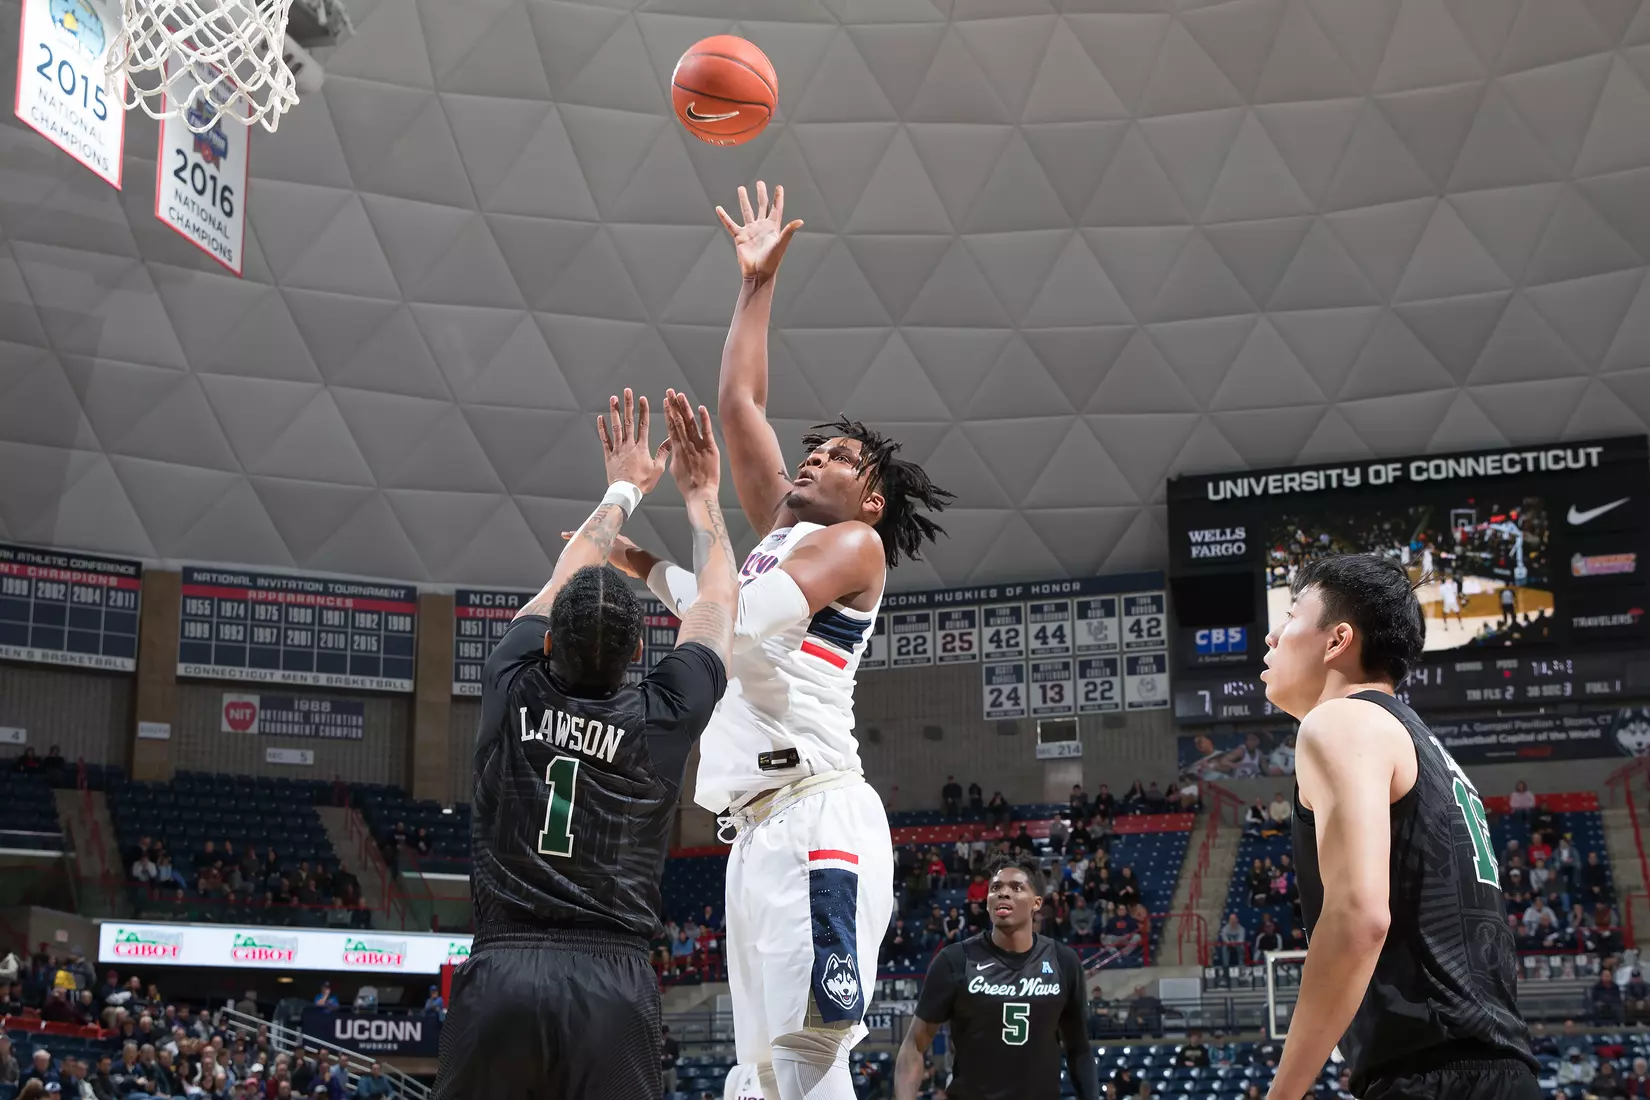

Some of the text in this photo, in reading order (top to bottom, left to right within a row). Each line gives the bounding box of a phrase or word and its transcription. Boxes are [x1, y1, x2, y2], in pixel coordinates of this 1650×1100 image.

[36, 43, 108, 121] 2015
[38, 86, 106, 146] NATIONAL
[31, 106, 109, 172] CHAMPIONS
[173, 148, 234, 219] 2016
[174, 188, 230, 240] NATIONAL
[168, 205, 233, 262] CHAMPIONS
[1207, 446, 1604, 501] UNIVERSITY OF CONNECTICUT
[1188, 527, 1246, 544] WELLS
[1191, 541, 1246, 559] FARGO
[27, 566, 118, 586] CHAMPIONS
[193, 572, 407, 599] NATIONAL INVITATION TOURNAMENT
[37, 582, 66, 600] 2002
[72, 586, 101, 604] 2004
[108, 591, 136, 609] 2011
[248, 590, 354, 608] APPEARANCES
[469, 594, 519, 606] NCAA
[935, 588, 998, 602] HUSKIES
[1006, 586, 1024, 597] OF
[1031, 582, 1081, 595] HONOR
[186, 599, 211, 616] 1955
[220, 601, 245, 618] 1974
[254, 604, 279, 621] 1975
[460, 620, 482, 636] 1951
[1034, 624, 1066, 645] 44
[1129, 617, 1161, 638] 42
[1195, 627, 1242, 645] CBS
[253, 627, 277, 644] 1997
[287, 629, 312, 647] 2001
[320, 632, 346, 649] 2010
[353, 635, 378, 652] 2015
[897, 635, 927, 657] 22
[942, 631, 973, 653] 25
[988, 628, 1020, 649] 42
[41, 651, 128, 669] BASKETBALL
[459, 642, 482, 658] 1963
[184, 665, 276, 681] CONNECTICUT
[326, 676, 408, 691] BASKETBALL
[460, 665, 481, 680] 1991
[989, 686, 1020, 708] 24
[1039, 684, 1064, 705] 13
[1084, 680, 1114, 702] 22
[1505, 685, 1515, 700] 2
[229, 708, 253, 721] NIT
[294, 699, 332, 712] 1988
[260, 709, 363, 726] NATIONAL INVITATION
[1473, 721, 1513, 734] Gampel
[1515, 718, 1554, 730] Pavilion
[1597, 714, 1612, 725] CT
[11, 731, 20, 741] 4
[260, 721, 363, 739] TOURNAMENT CHAMPION
[519, 707, 625, 763] LAWSON
[1445, 728, 1601, 746] Basketball Capital of the World
[538, 756, 579, 858] 1
[1041, 960, 1054, 974] A
[968, 975, 1060, 997] Green Wave
[334, 1018, 422, 1042] UCONN
[867, 1014, 891, 1028] 113
[1001, 1002, 1031, 1046] 5
[358, 1042, 398, 1051] HUSKIES
